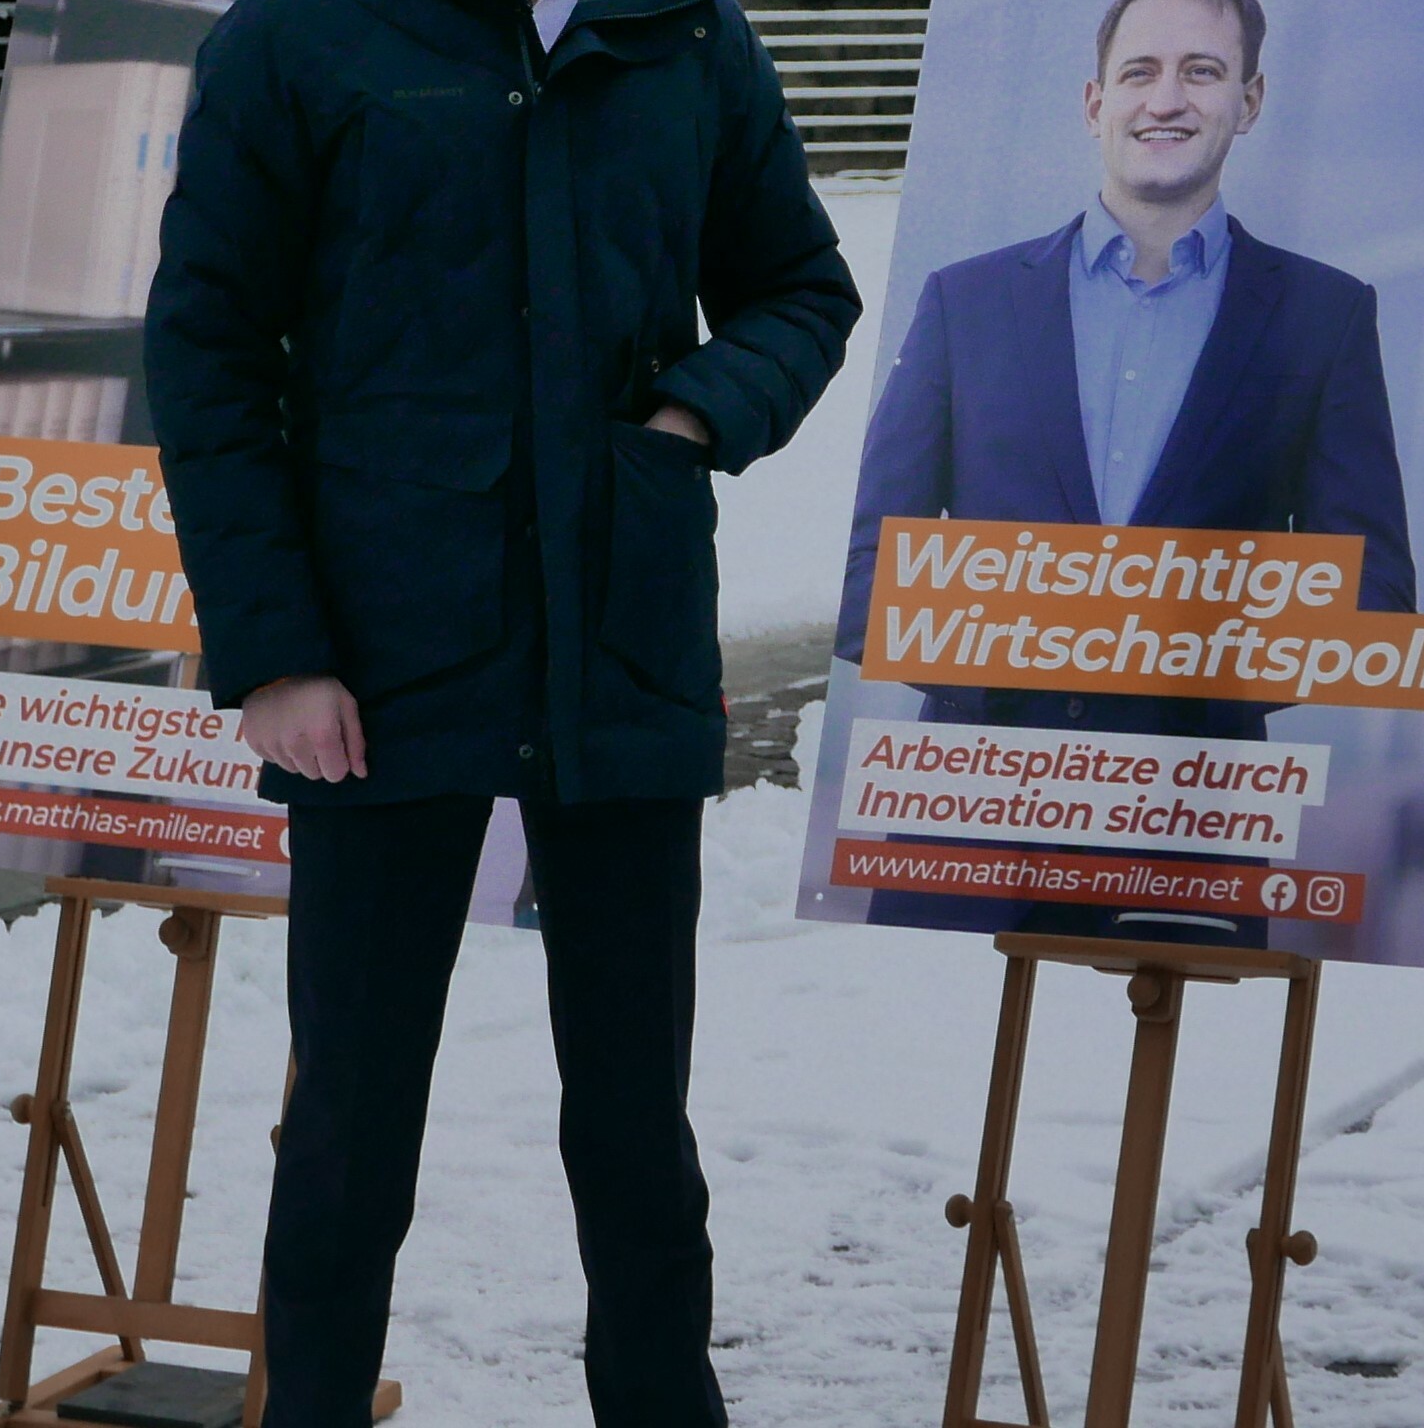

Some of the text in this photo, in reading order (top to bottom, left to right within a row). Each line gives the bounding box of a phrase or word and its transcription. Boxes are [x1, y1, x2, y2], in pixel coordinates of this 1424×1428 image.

[896, 530, 1342, 617] Weitsichtige
[19, 689, 224, 743] wichtigste
[861, 733, 1309, 795] Arbeitsplätze durch
[856, 782, 1284, 844] Innovation sichern.
[847, 852, 1242, 902] www.matthias-miller.net
